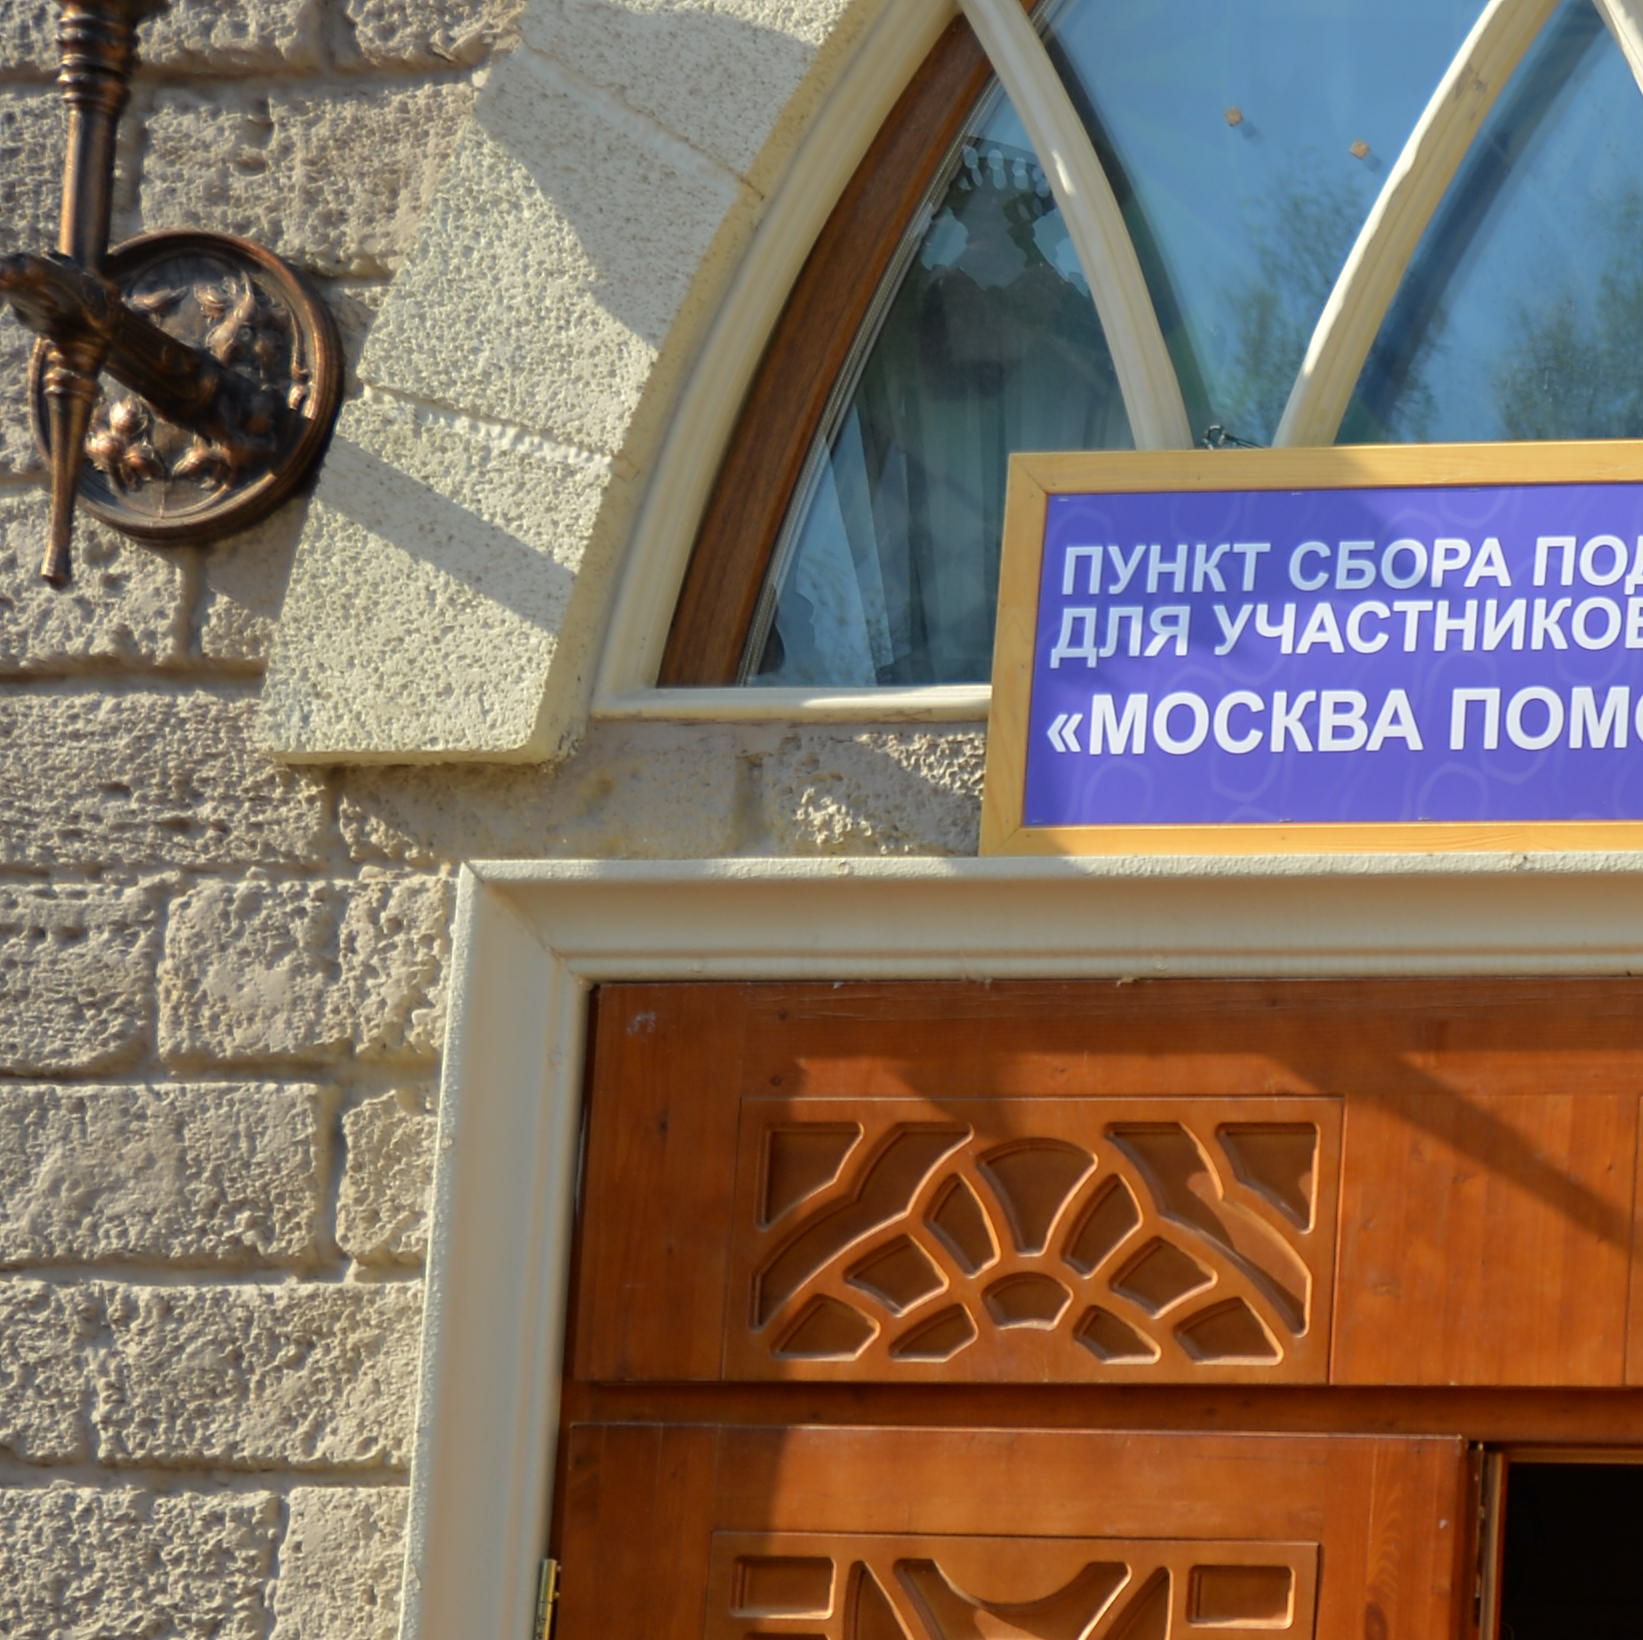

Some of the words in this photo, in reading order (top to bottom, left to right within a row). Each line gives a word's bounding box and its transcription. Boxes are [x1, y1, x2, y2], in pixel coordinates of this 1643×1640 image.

[1061, 541, 1271, 596] ПУНКТ
[1288, 537, 1512, 592] СБОРА
[1050, 605, 1191, 669] ДЛЯ
[1046, 689, 1424, 755] «МОСКВА
